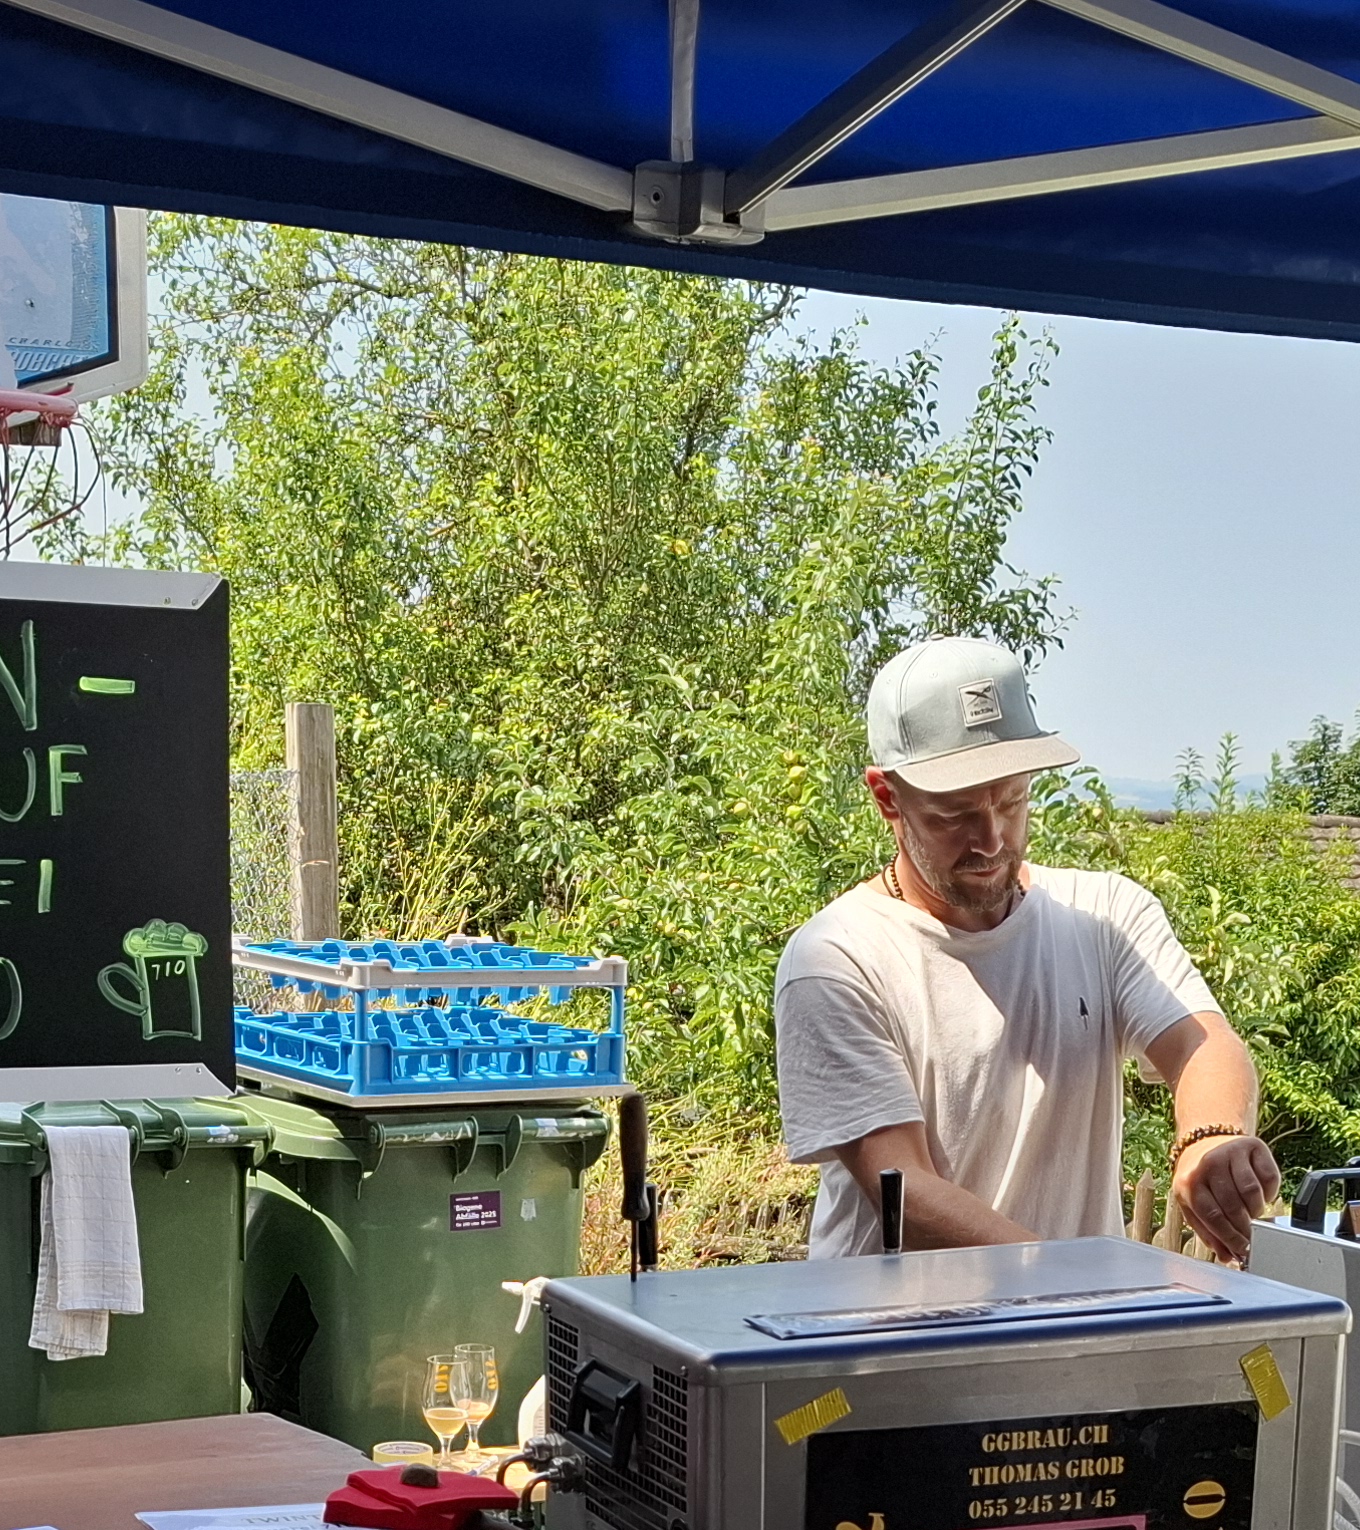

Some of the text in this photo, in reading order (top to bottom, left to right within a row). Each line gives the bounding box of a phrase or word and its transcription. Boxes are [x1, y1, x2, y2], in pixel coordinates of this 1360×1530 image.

[151, 960, 188, 981] 710
[981, 1424, 1109, 1453] GGBRAU.CH
[968, 1456, 1125, 1487] THOMAS GROB
[968, 1488, 1117, 1520] 055 245 21 45
